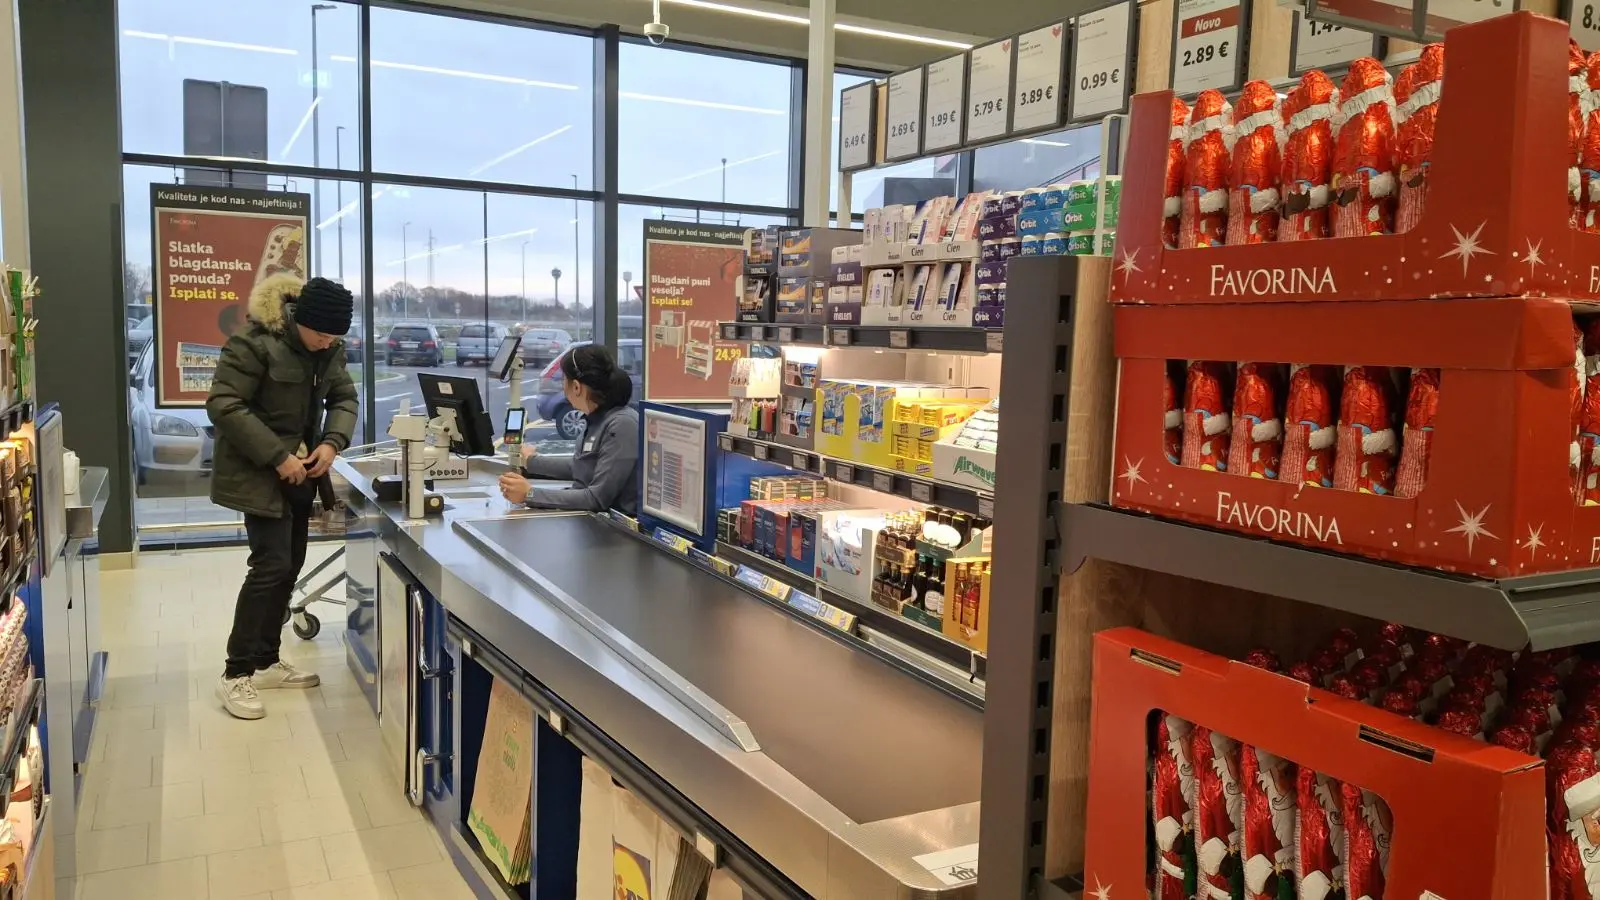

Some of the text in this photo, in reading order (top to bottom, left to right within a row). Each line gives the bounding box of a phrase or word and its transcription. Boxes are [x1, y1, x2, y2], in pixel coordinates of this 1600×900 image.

[1583, 4, 1600, 32] 8.
[1194, 17, 1222, 33] Novo
[1182, 41, 1229, 67] 2.89 €
[1080, 68, 1120, 91] 0.99 €
[1020, 85, 1054, 106] 3.89 €
[974, 98, 1003, 117] 5.79 €
[931, 110, 956, 128] 1.99 €
[891, 121, 916, 138] 2.69 €
[844, 133, 866, 149] 6.49 €
[158, 191, 197, 202] Kvaliteta
[200, 194, 208, 204] je
[211, 194, 227, 204] kod
[230, 197, 245, 205] nas
[252, 198, 297, 210] najjeftinija
[1020, 219, 1037, 230] Orbit
[1064, 212, 1083, 224] Orbit
[649, 226, 677, 235] Kvaliteta
[678, 229, 685, 237] je
[980, 225, 995, 234] Orbit
[168, 241, 214, 254] Slatka
[911, 247, 924, 257] Cien
[946, 244, 961, 253] Cien
[169, 256, 252, 272] blagdanska
[977, 267, 992, 278] Orbit
[169, 273, 231, 286] ponuda?
[651, 275, 711, 287] Blagdani puni
[1210, 264, 1338, 296] FAVORINA
[169, 286, 239, 301] Isplati se.
[651, 287, 685, 297] veselja?
[651, 296, 693, 307] Isplati se!
[910, 312, 923, 321] Cien
[943, 312, 957, 321] Cien
[975, 312, 990, 321] Orbit
[715, 348, 742, 361] 24.99
[1216, 491, 1343, 544] FAVORINA
